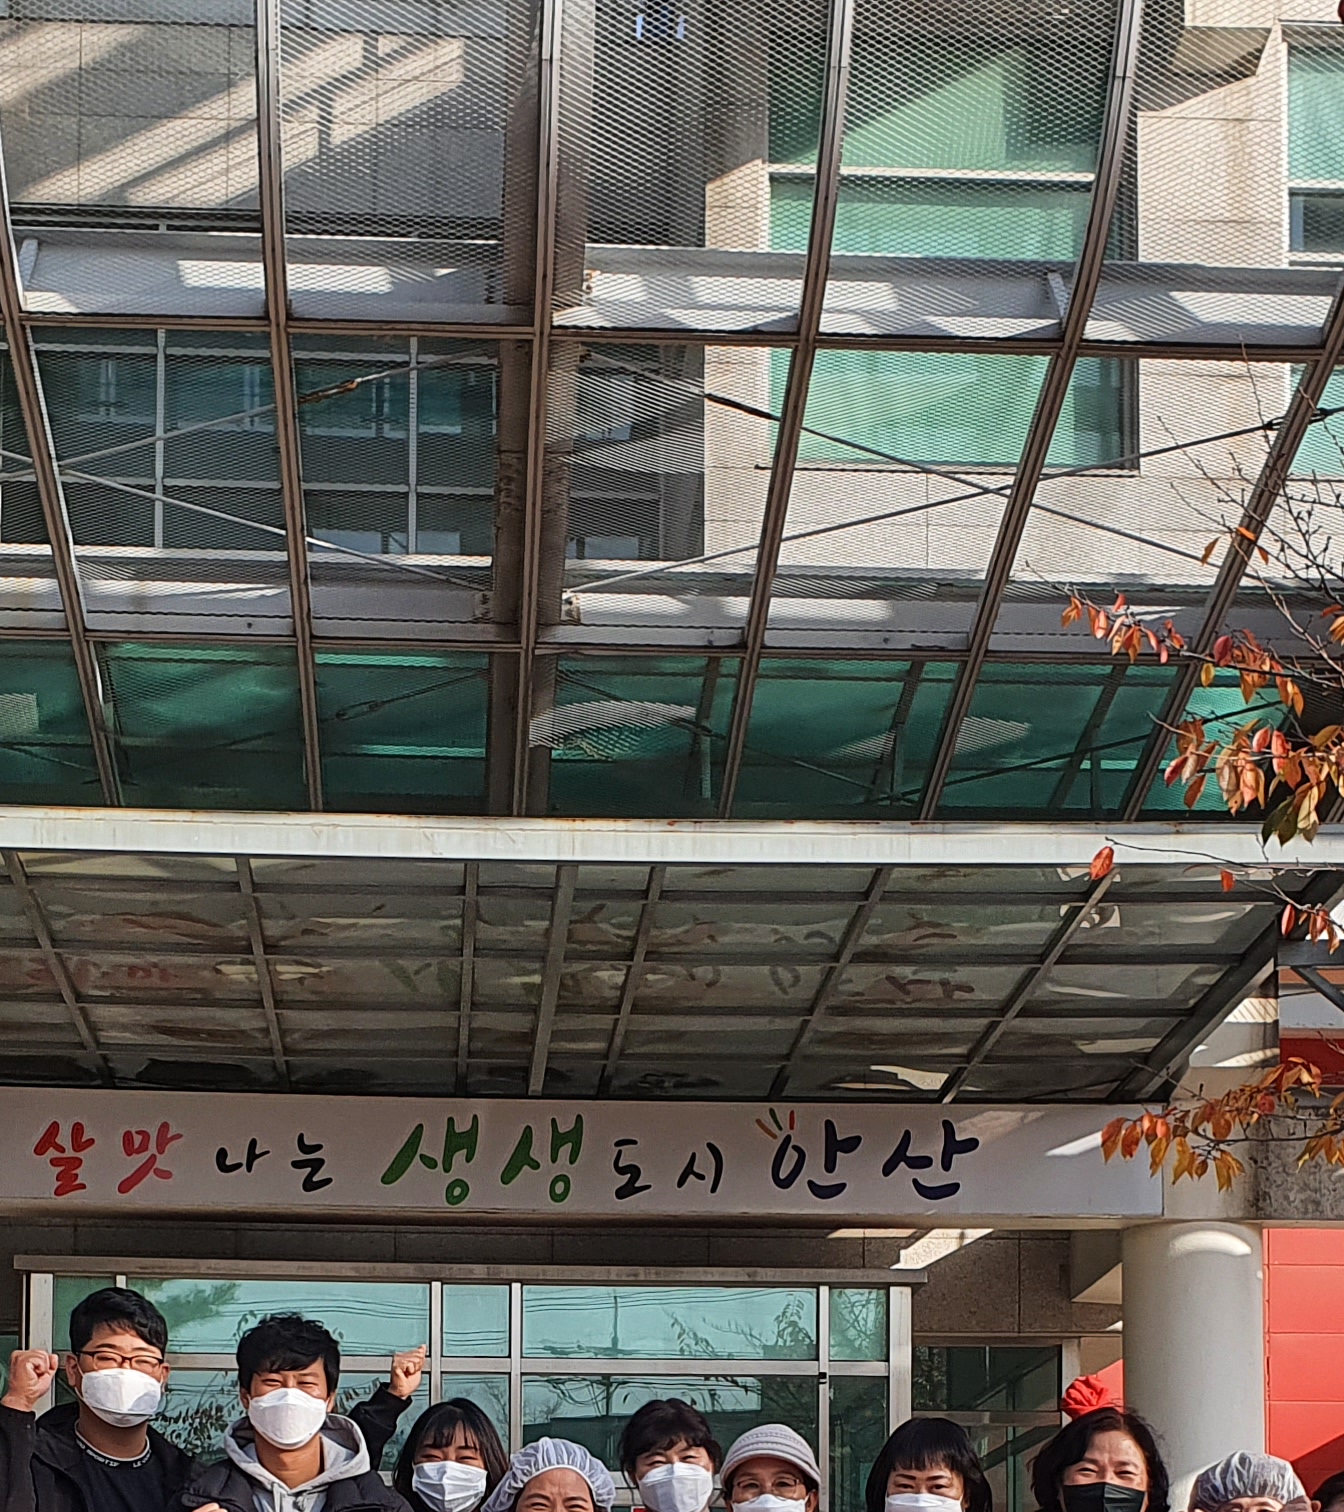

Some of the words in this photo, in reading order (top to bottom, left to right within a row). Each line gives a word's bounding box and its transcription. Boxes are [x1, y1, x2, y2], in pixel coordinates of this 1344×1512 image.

[33, 1120, 184, 1196] 살맛
[216, 1131, 335, 1194] 나는
[380, 1113, 585, 1206] 생생
[611, 1136, 726, 1196] 도시
[768, 1113, 981, 1202] 안산
